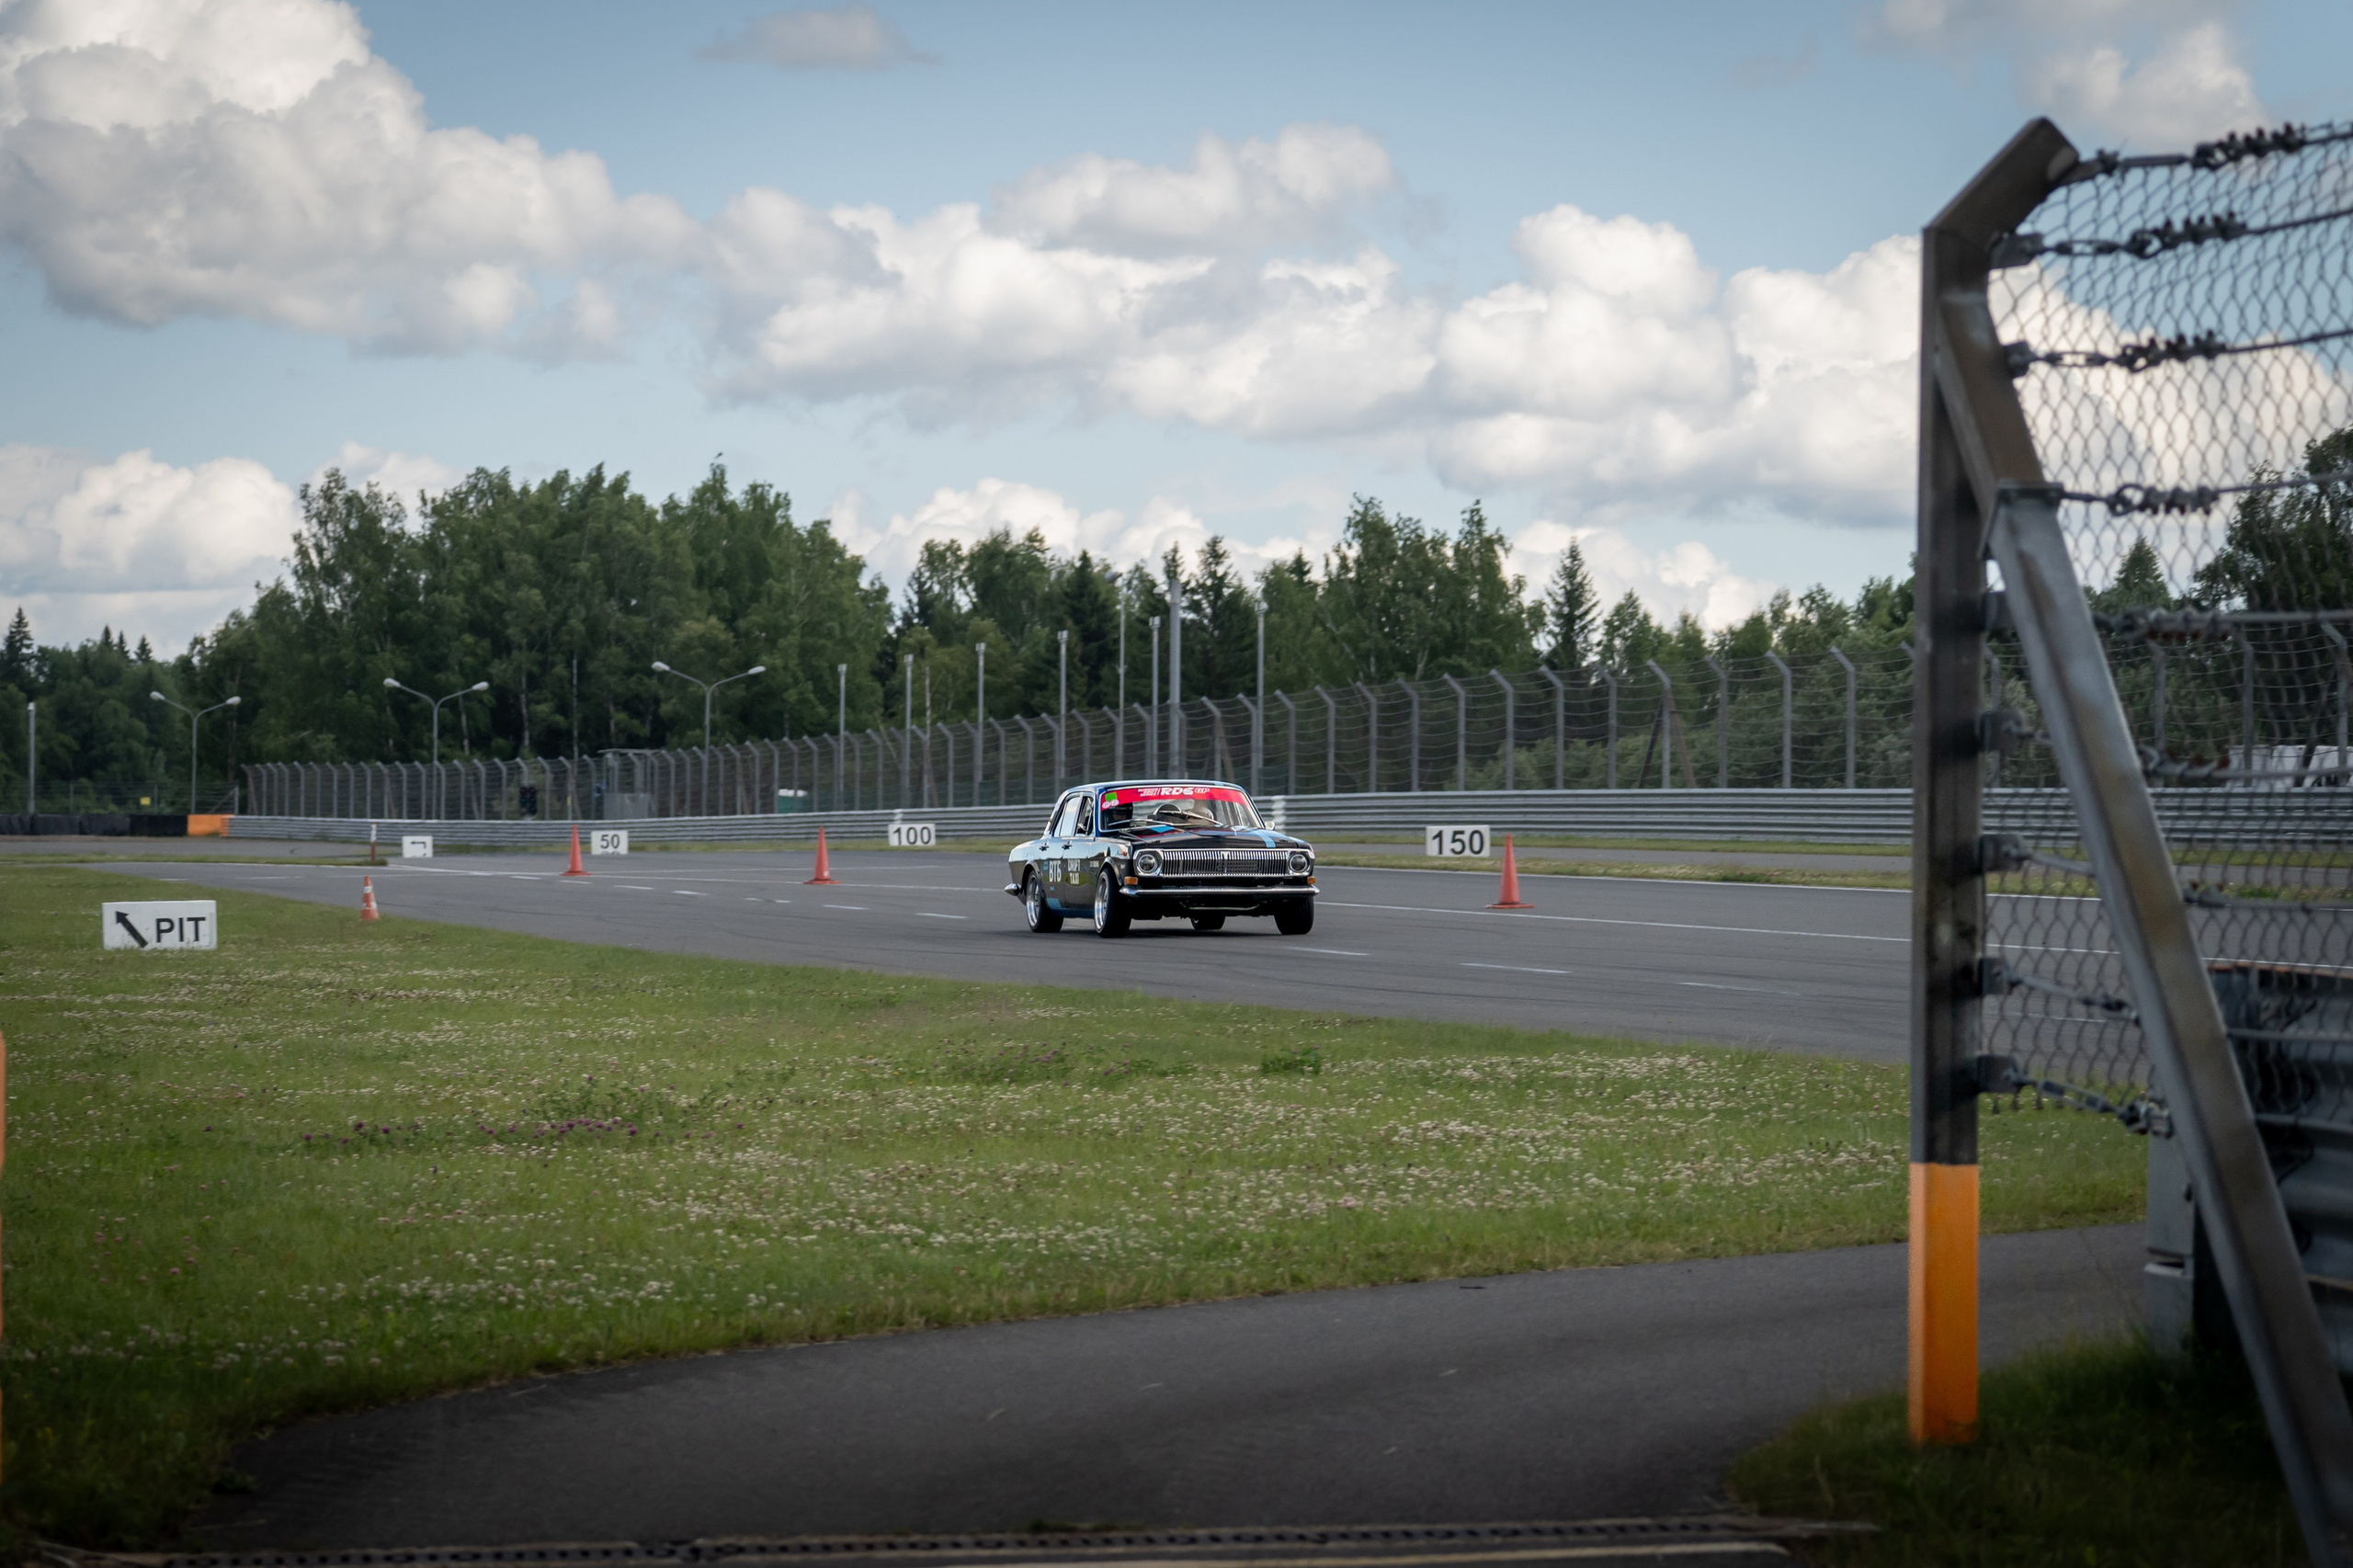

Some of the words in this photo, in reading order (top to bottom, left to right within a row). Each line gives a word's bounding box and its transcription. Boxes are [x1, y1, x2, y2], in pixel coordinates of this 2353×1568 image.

[600, 834, 620, 849] 50
[892, 826, 931, 846] 100
[1432, 830, 1484, 855] 150
[1049, 860, 1062, 882] ВТБ
[1067, 858, 1081, 872] DRIFT
[1069, 872, 1080, 884] TAXI
[155, 916, 207, 943] PIT
